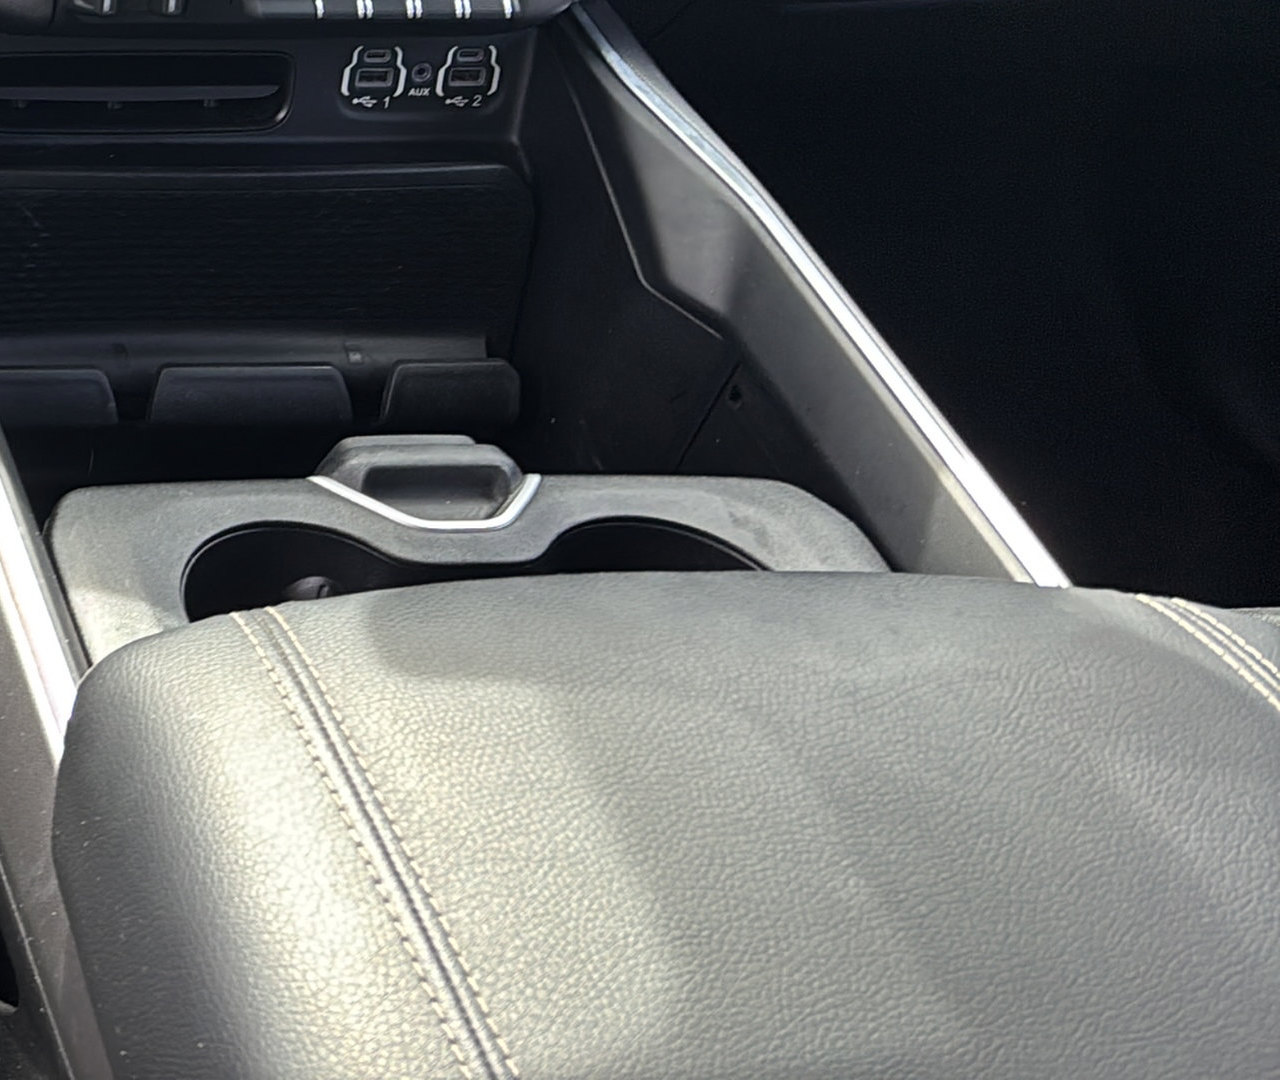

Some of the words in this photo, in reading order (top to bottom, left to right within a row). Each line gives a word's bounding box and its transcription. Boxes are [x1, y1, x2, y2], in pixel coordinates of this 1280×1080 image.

[408, 88, 431, 96] AUX
[383, 96, 390, 109] 1
[472, 95, 482, 107] 2
